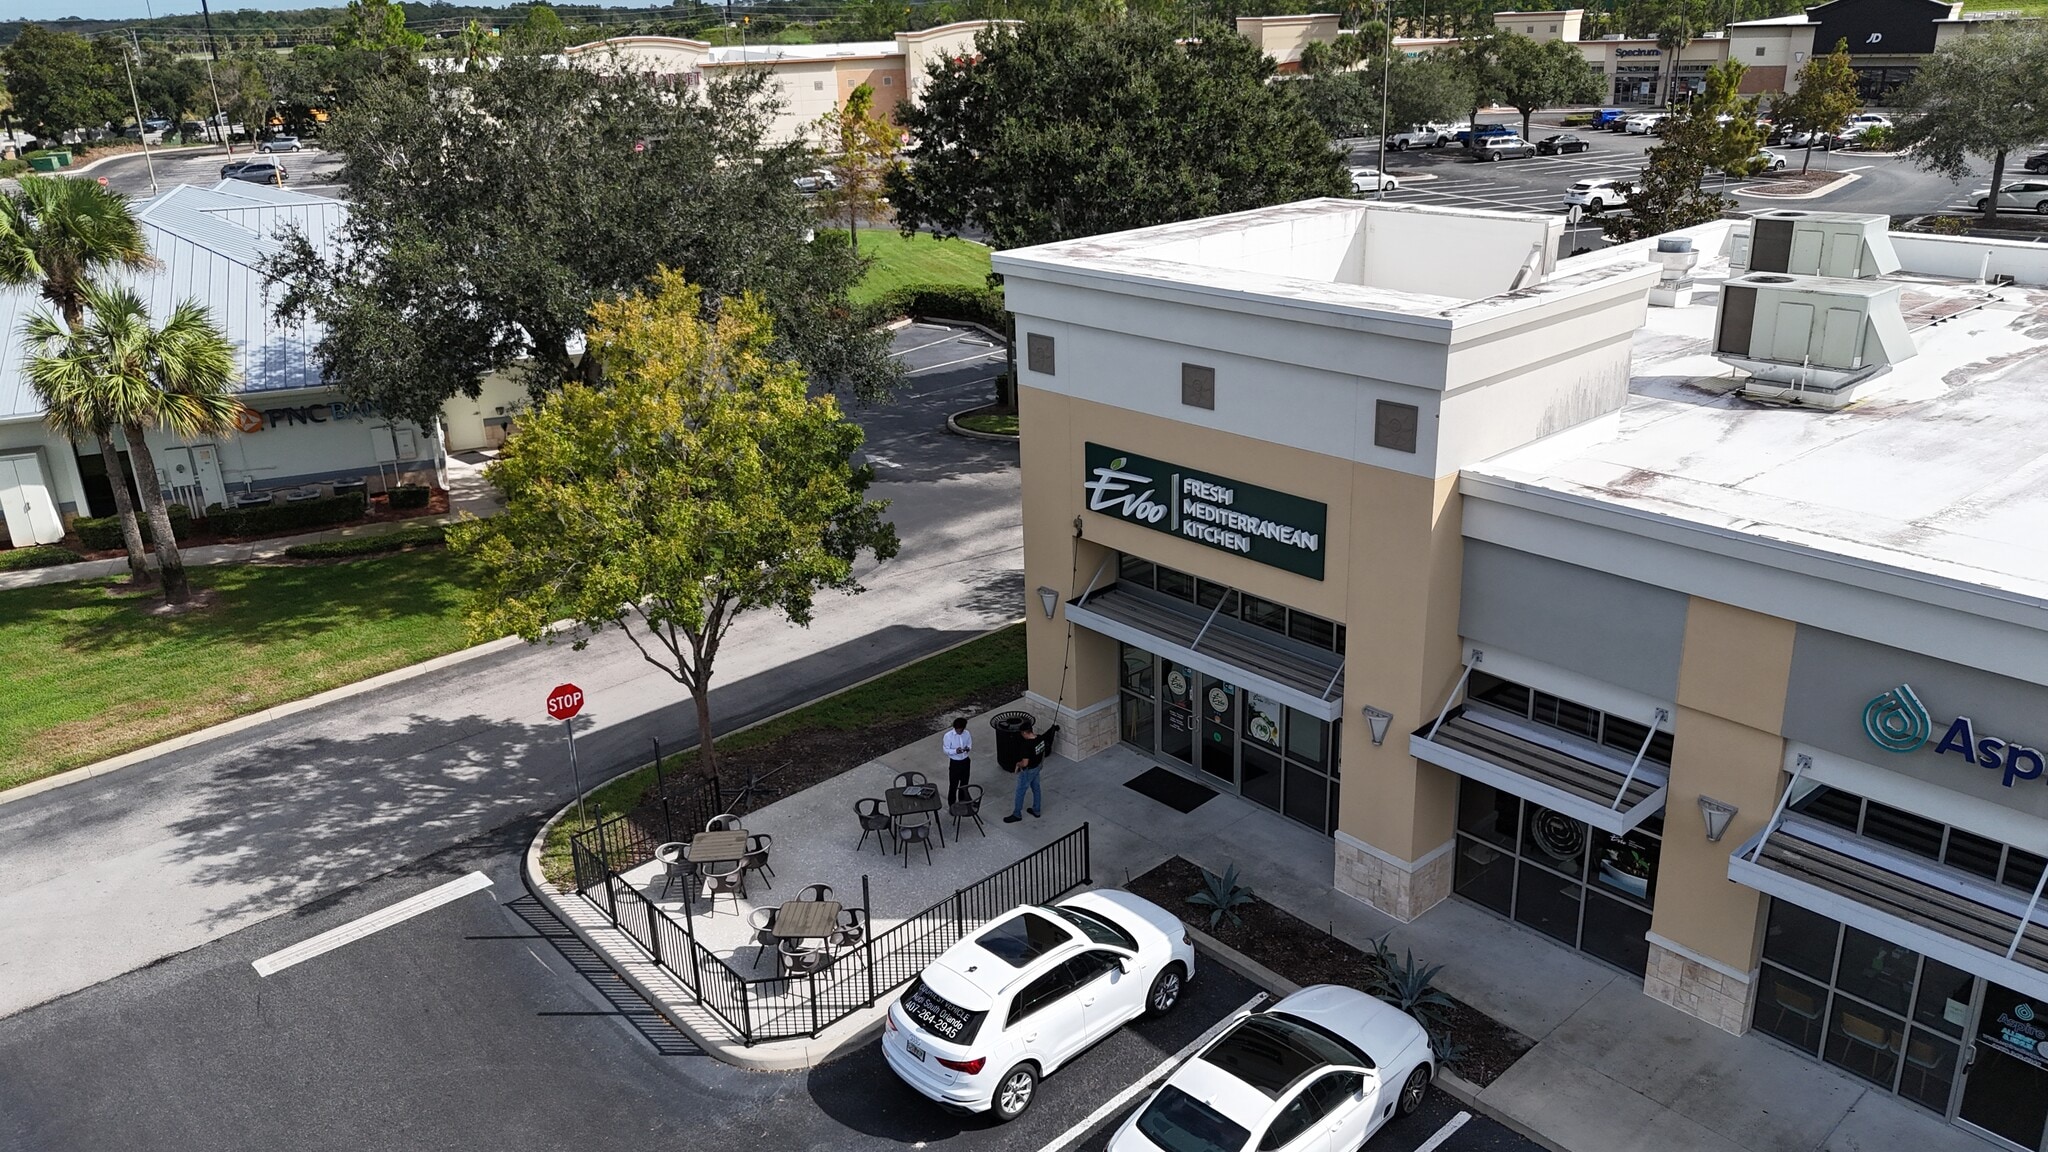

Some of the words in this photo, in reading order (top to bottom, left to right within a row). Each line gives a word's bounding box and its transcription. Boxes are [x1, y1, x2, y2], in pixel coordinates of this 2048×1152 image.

[1866, 33, 1882, 43] JD
[1615, 48, 1659, 58] Spectrum
[265, 404, 327, 428] PNC
[1085, 467, 1168, 523] Evoo
[1183, 478, 1233, 506] FRESH
[1183, 498, 1318, 552] MEDITERRANEAN
[1183, 518, 1250, 553] KITCHEN
[549, 692, 581, 712] STOP
[1934, 715, 2048, 788] Asp
[905, 1000, 958, 1039] 407-264-2945
[923, 999, 940, 1016] South
[939, 1008, 964, 1030] Orlando
[944, 998, 971, 1022] VEHICLE
